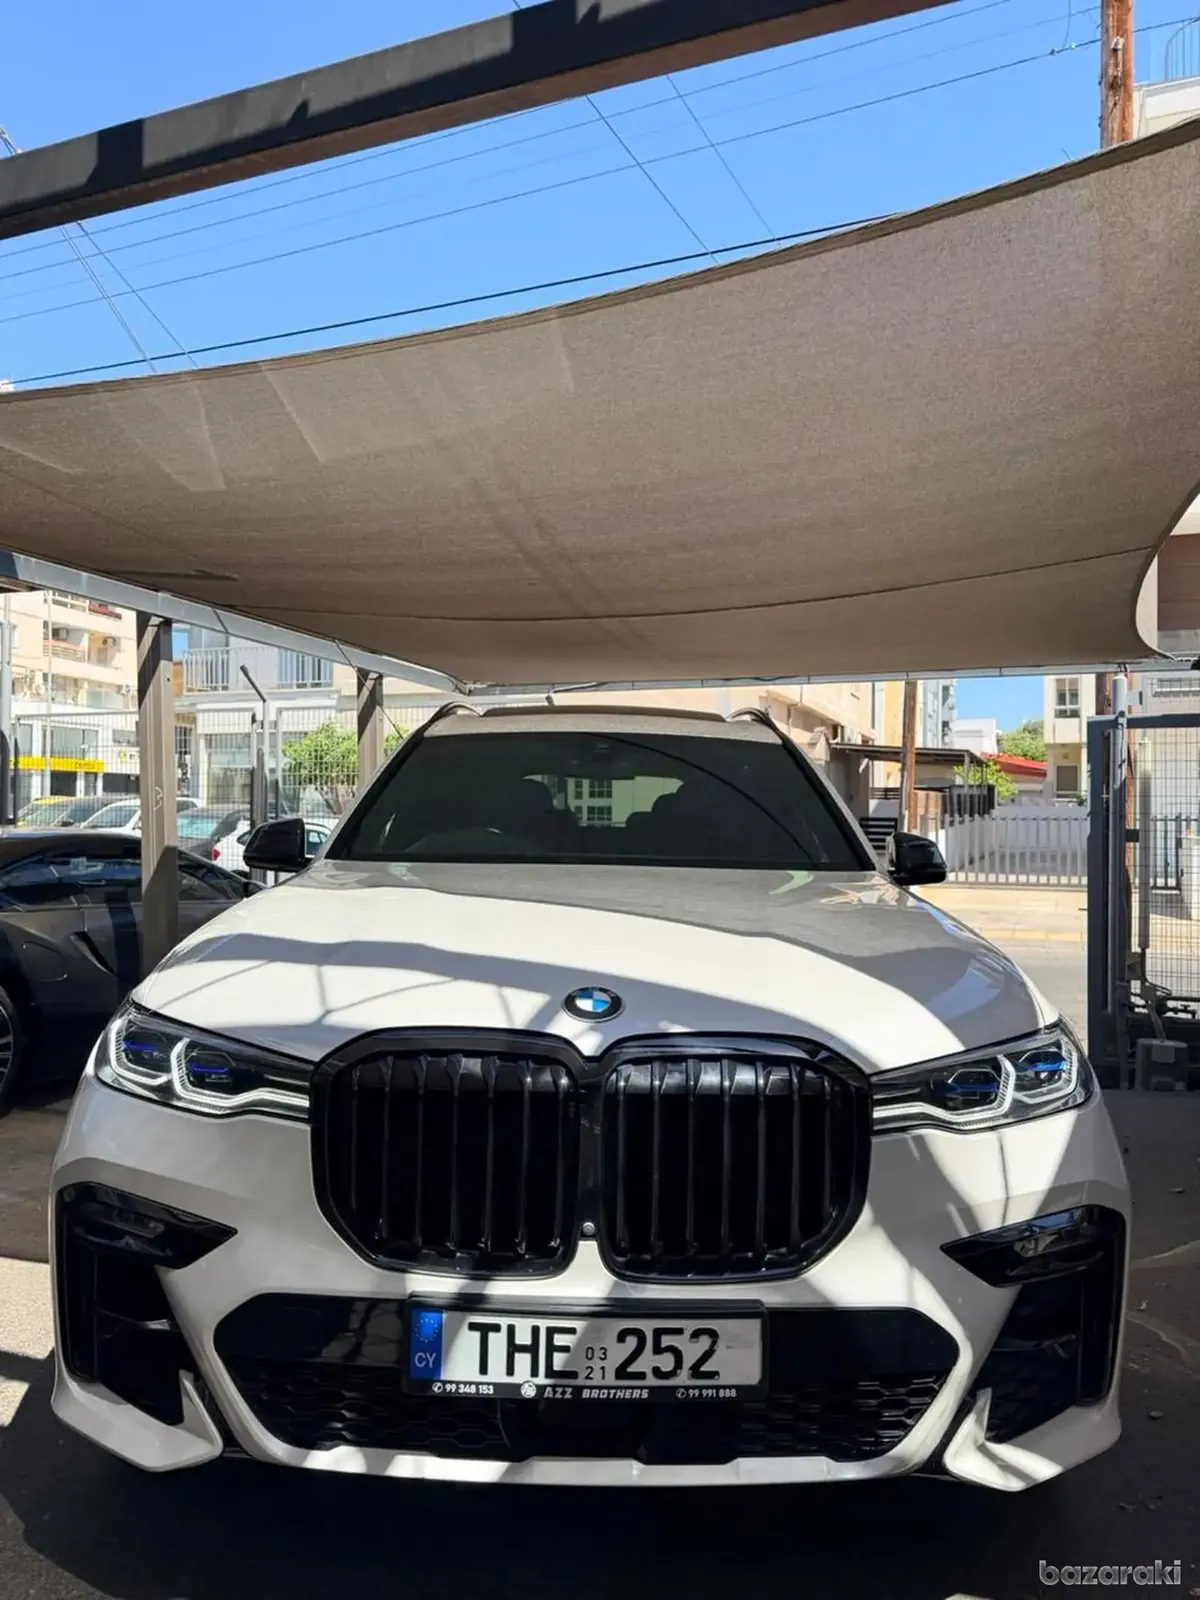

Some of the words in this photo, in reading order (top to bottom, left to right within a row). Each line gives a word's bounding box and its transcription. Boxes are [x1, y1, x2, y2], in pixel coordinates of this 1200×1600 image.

[467, 1322, 579, 1380] THE
[615, 1327, 720, 1380] 252
[585, 1346, 608, 1361] 03
[414, 1352, 436, 1368] CY
[584, 1365, 606, 1380] 21
[445, 1383, 457, 1393] 99
[458, 1384, 476, 1394] 348
[478, 1385, 494, 1395] 153
[543, 1386, 573, 1399] AZZ
[581, 1388, 649, 1399] BROTHERS
[688, 1388, 700, 1398] 99
[701, 1388, 717, 1398] 991
